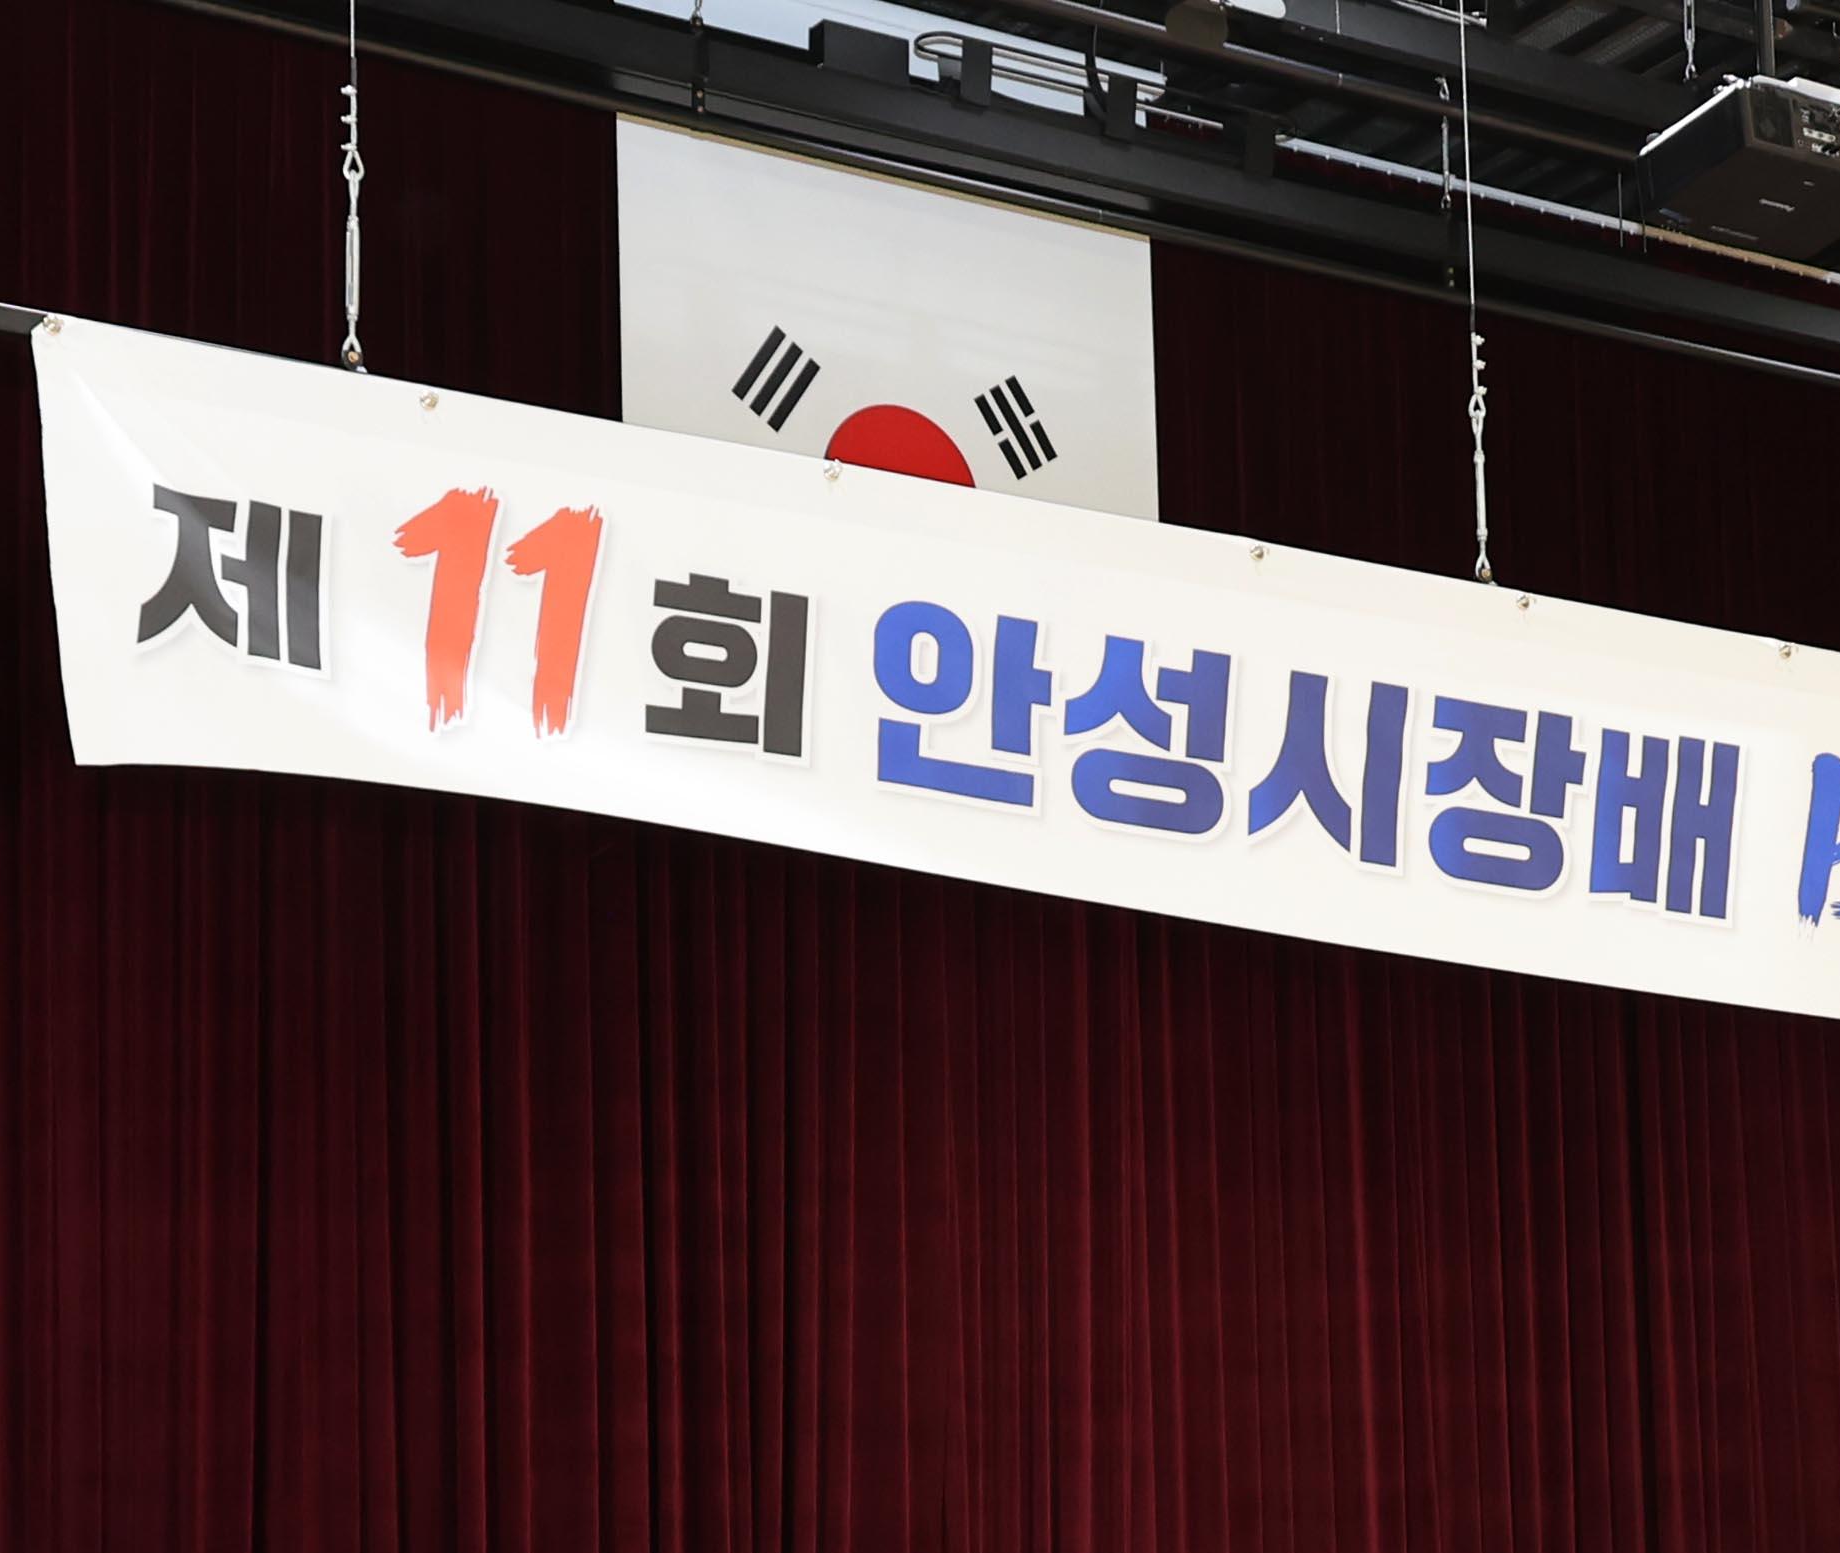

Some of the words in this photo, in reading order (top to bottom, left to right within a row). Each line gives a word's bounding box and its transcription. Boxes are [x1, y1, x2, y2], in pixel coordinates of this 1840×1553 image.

[137, 483, 323, 671] 제
[392, 486, 604, 739] 11
[645, 573, 809, 757] 회
[874, 601, 1740, 919] 안성시장배
